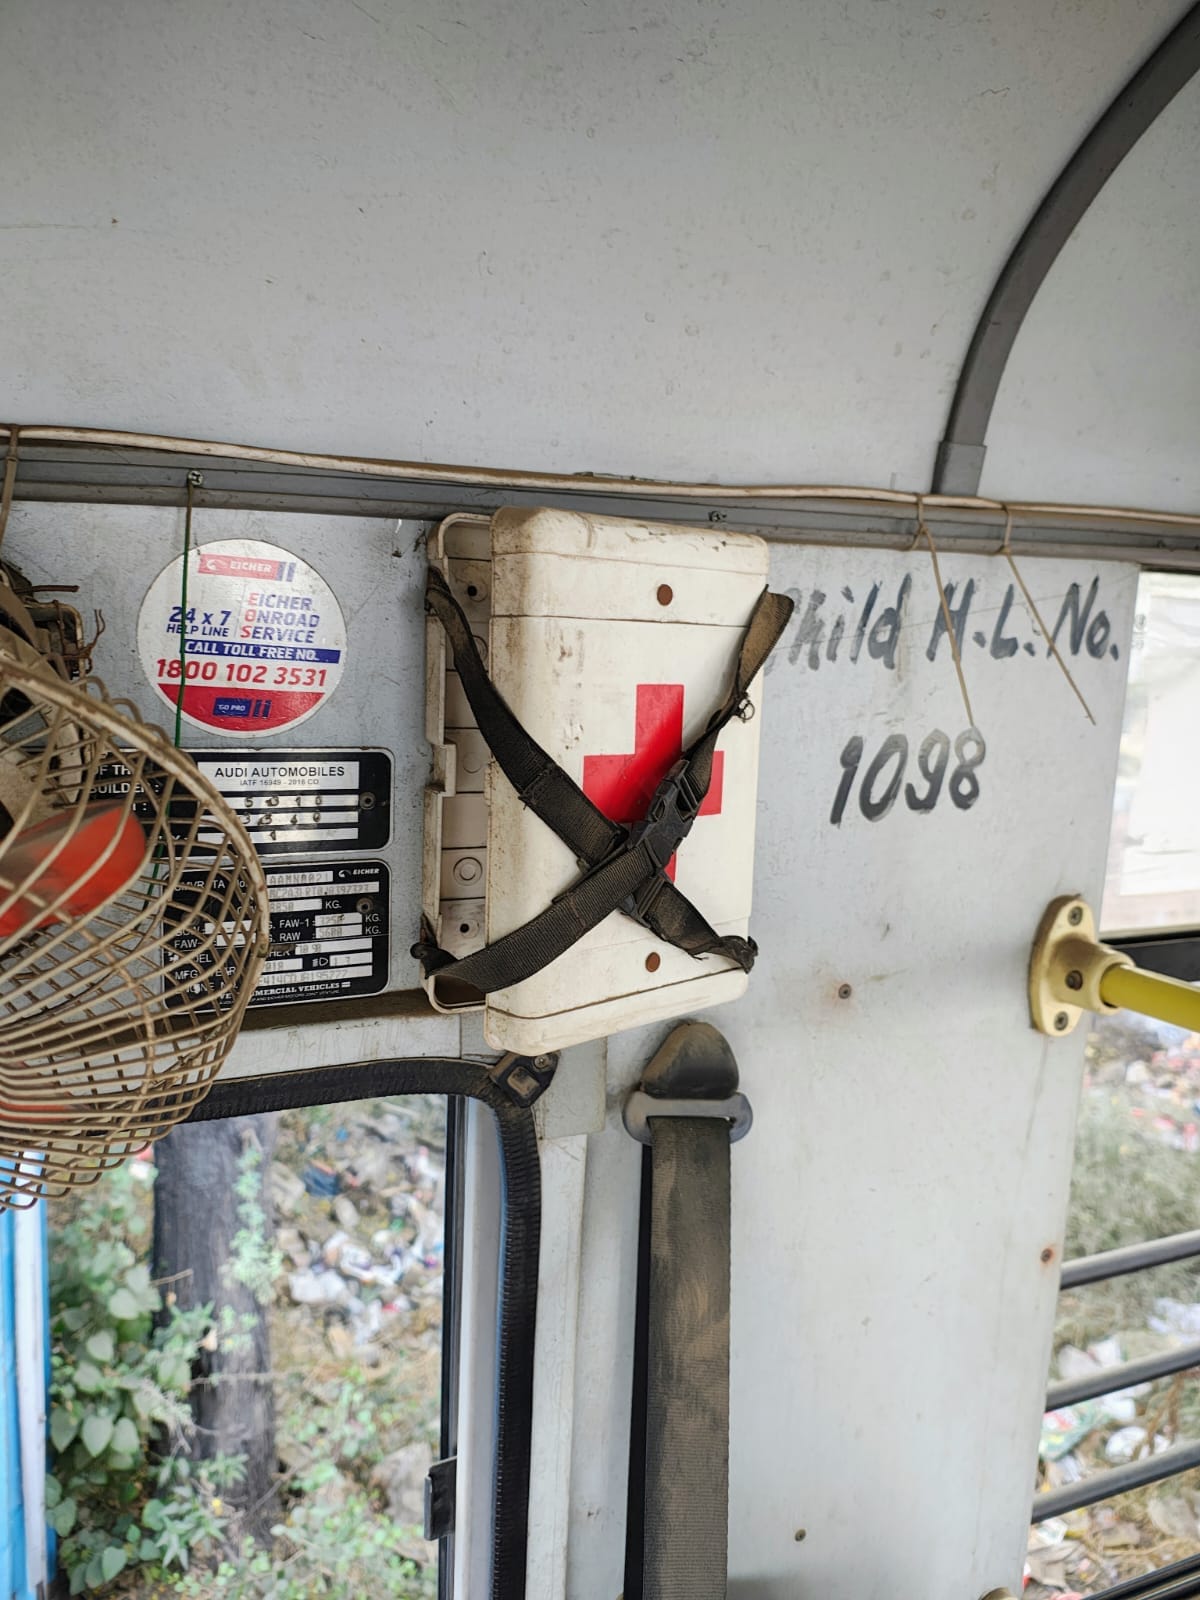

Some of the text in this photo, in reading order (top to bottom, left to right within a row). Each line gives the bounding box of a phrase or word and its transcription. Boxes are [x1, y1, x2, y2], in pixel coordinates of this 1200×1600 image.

[230, 561, 273, 573] EICHER
[247, 592, 313, 611] EICHER
[169, 606, 196, 625] 24
[220, 610, 232, 626] 7
[244, 609, 320, 628] ONROAD
[1046, 575, 1120, 662] No.
[166, 623, 230, 638] HELP LINE
[240, 625, 315, 644] SERVICE
[184, 640, 319, 662] CALL TOLL FREE NO.
[157, 658, 328, 687] 1800 102 3531
[214, 765, 345, 778] AUDI AUTOMOBILES
[830, 726, 986, 827] 1098
[279, 918, 309, 928] FAW-1
[279, 932, 301, 942] RAW
[252, 982, 340, 997] MERCIAL VEHICLES
